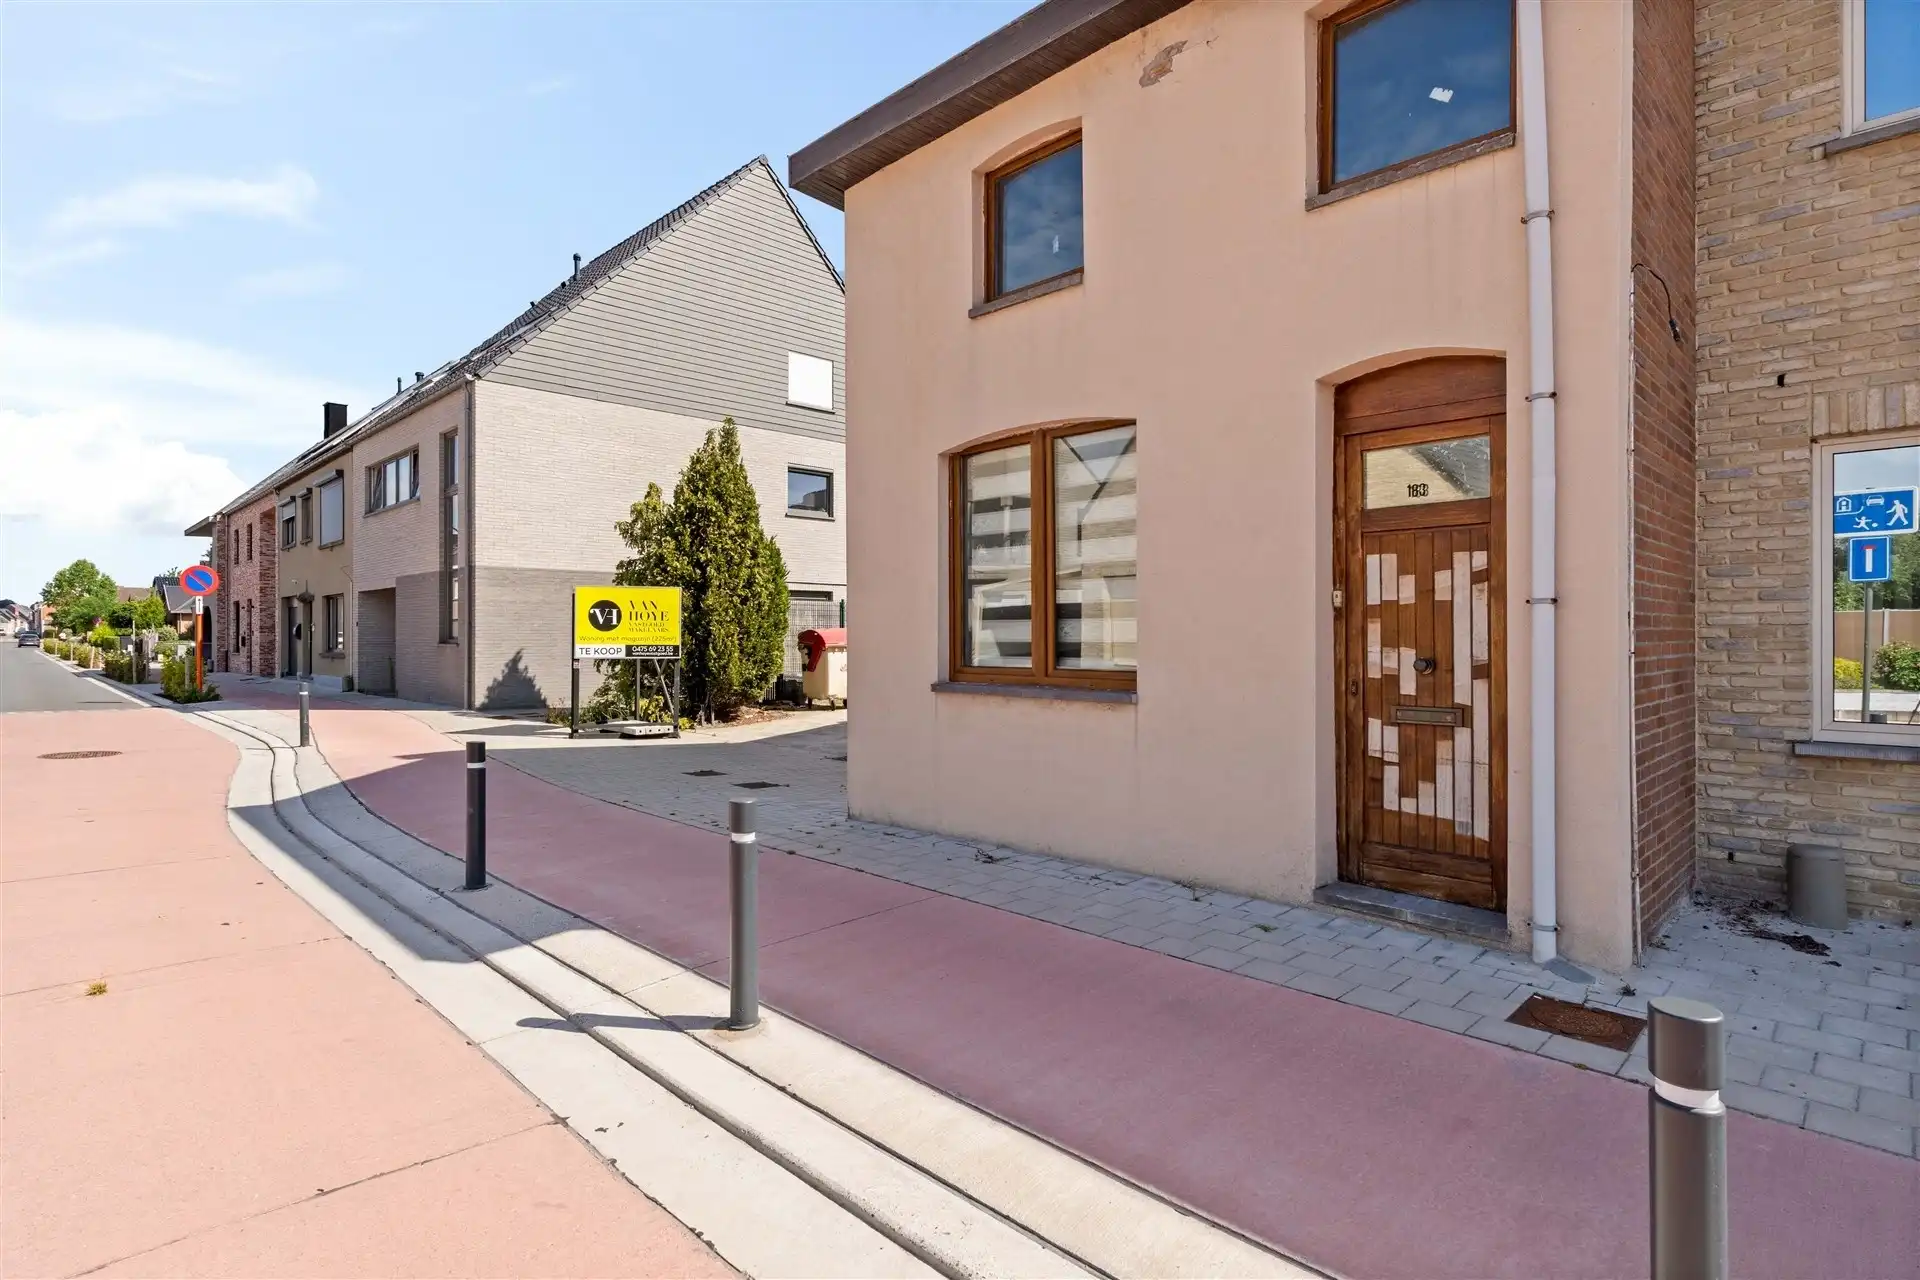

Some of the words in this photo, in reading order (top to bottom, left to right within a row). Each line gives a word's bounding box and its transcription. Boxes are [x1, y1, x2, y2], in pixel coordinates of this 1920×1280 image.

[629, 600, 658, 610] VAN
[629, 611, 670, 621] HOYE
[579, 647, 591, 655] TE
[594, 647, 622, 655] KOOP
